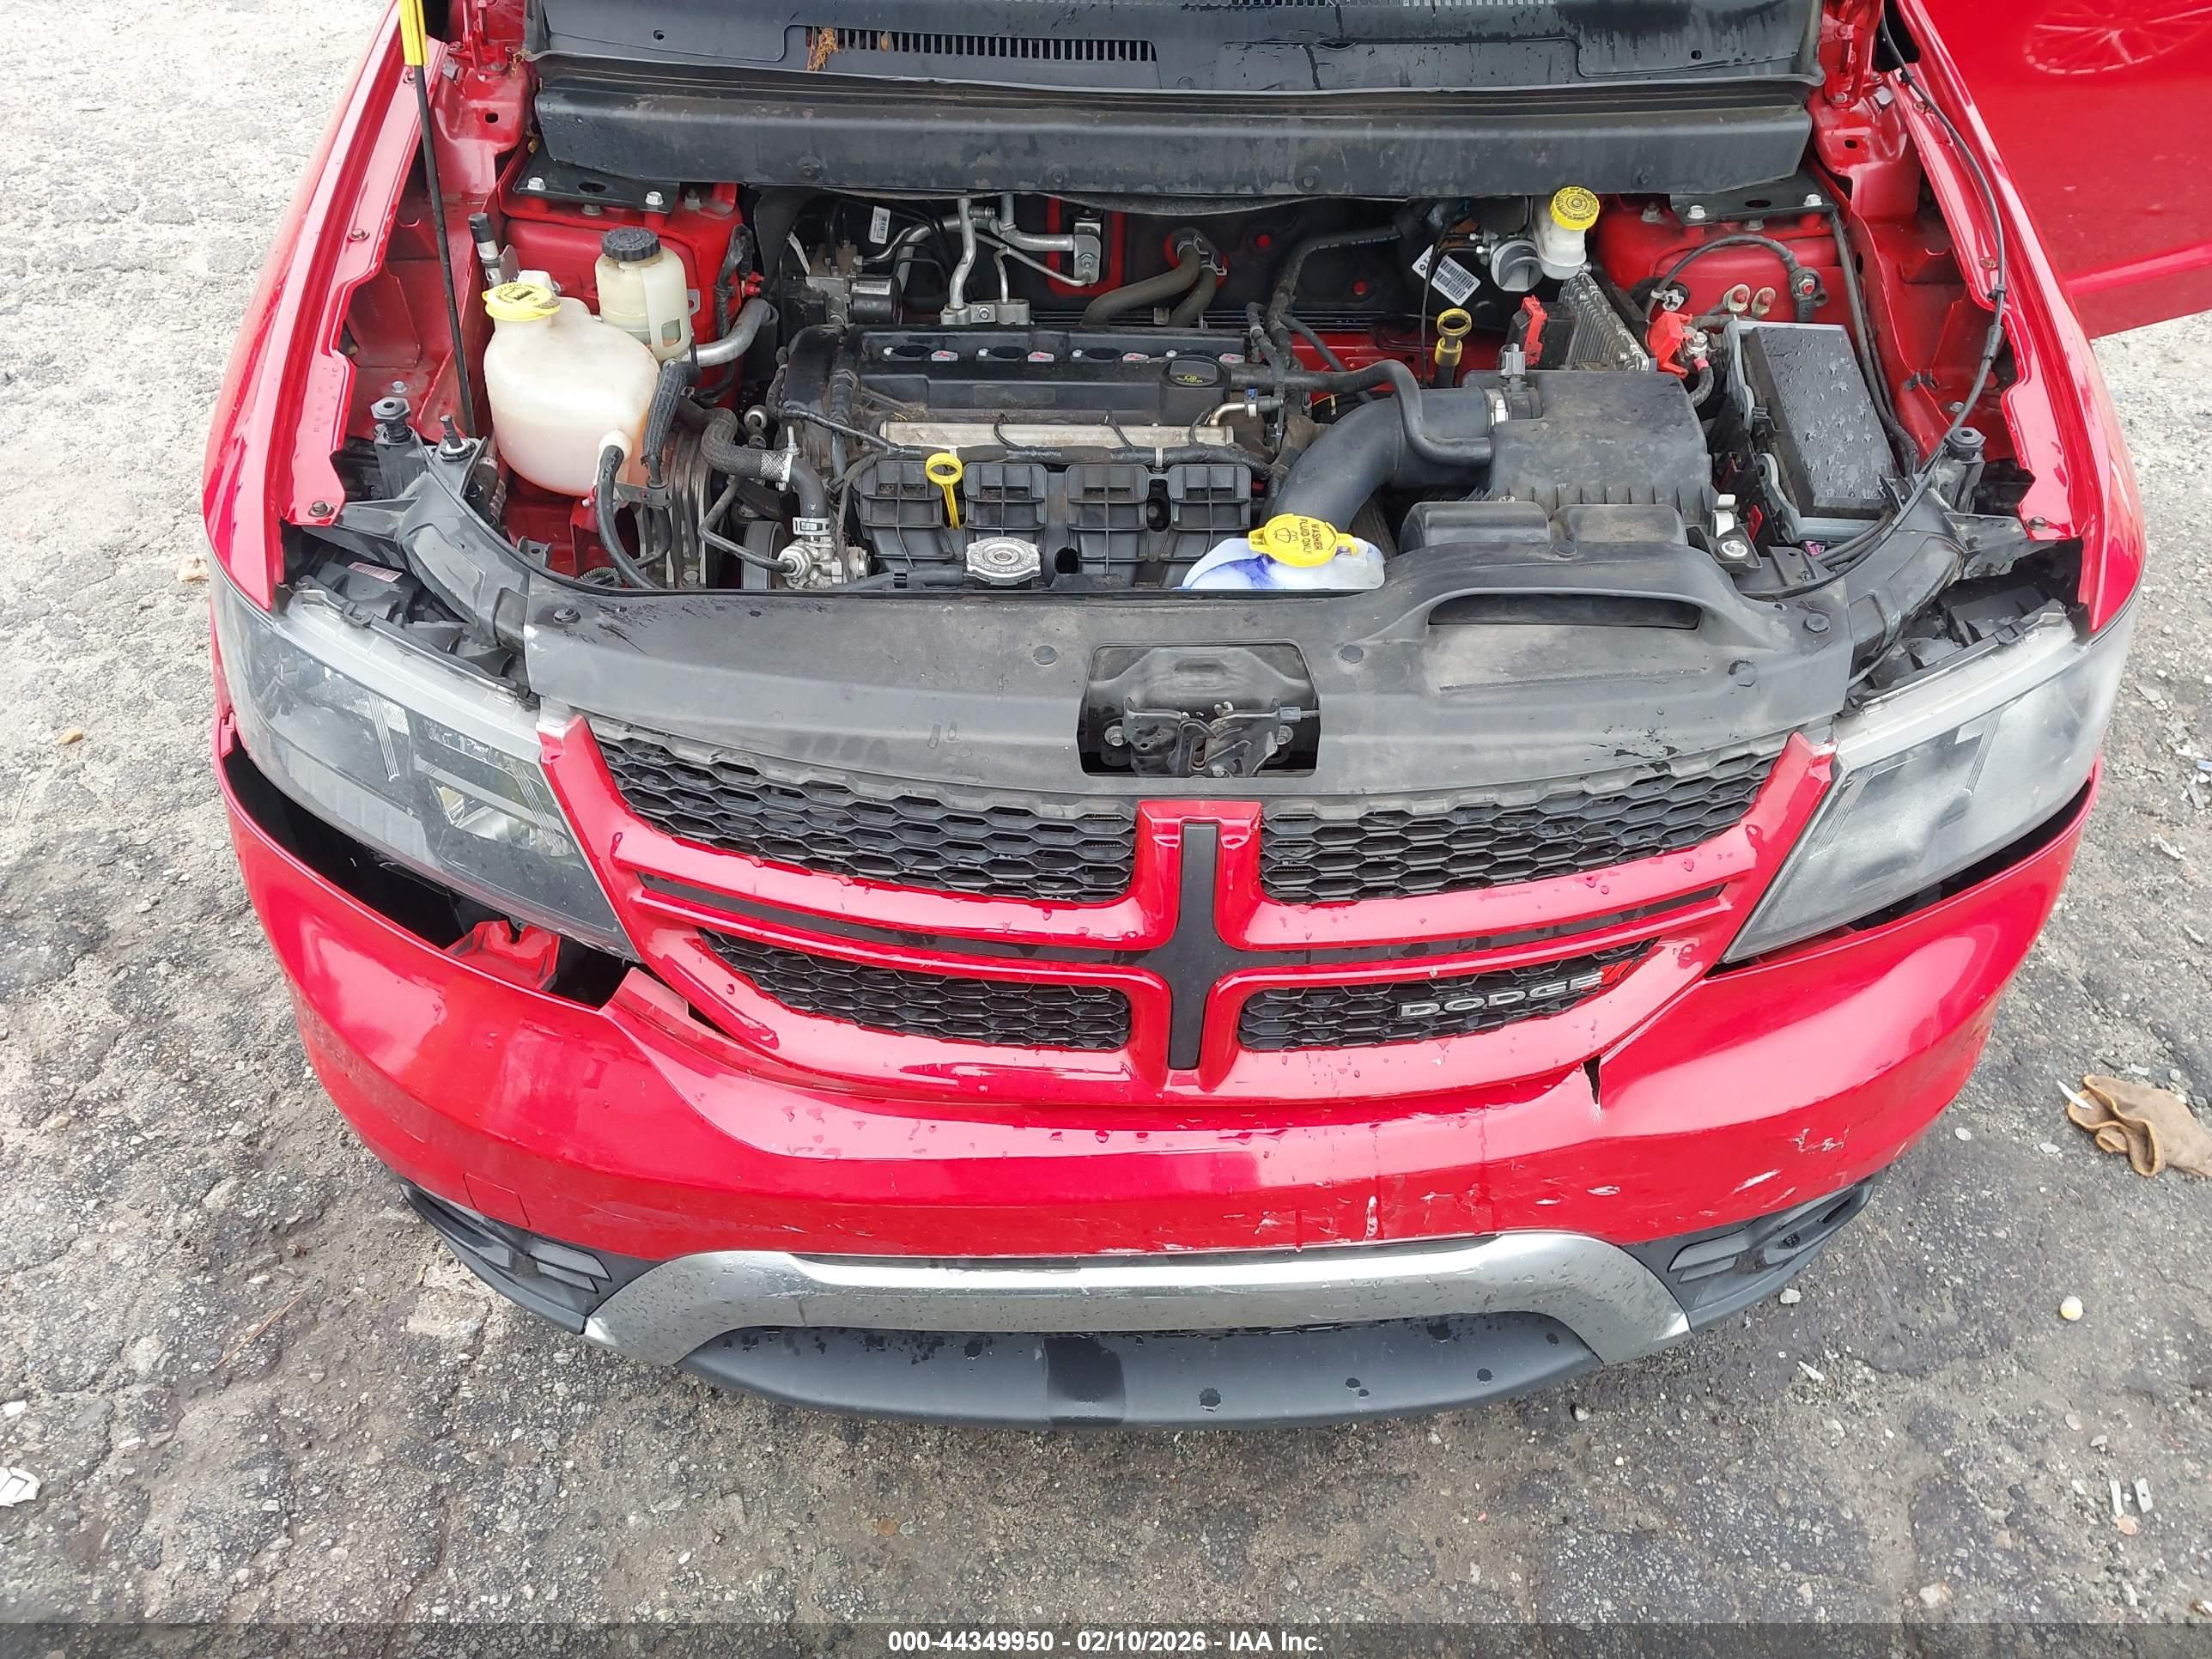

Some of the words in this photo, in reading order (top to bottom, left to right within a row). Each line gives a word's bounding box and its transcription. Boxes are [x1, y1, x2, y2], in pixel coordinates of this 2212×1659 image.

[1299, 519, 1310, 537] FLUID
[1311, 523, 1323, 550] WASHER
[1302, 538, 1313, 554] ONLY
[1401, 970, 1604, 1018] DODGE
